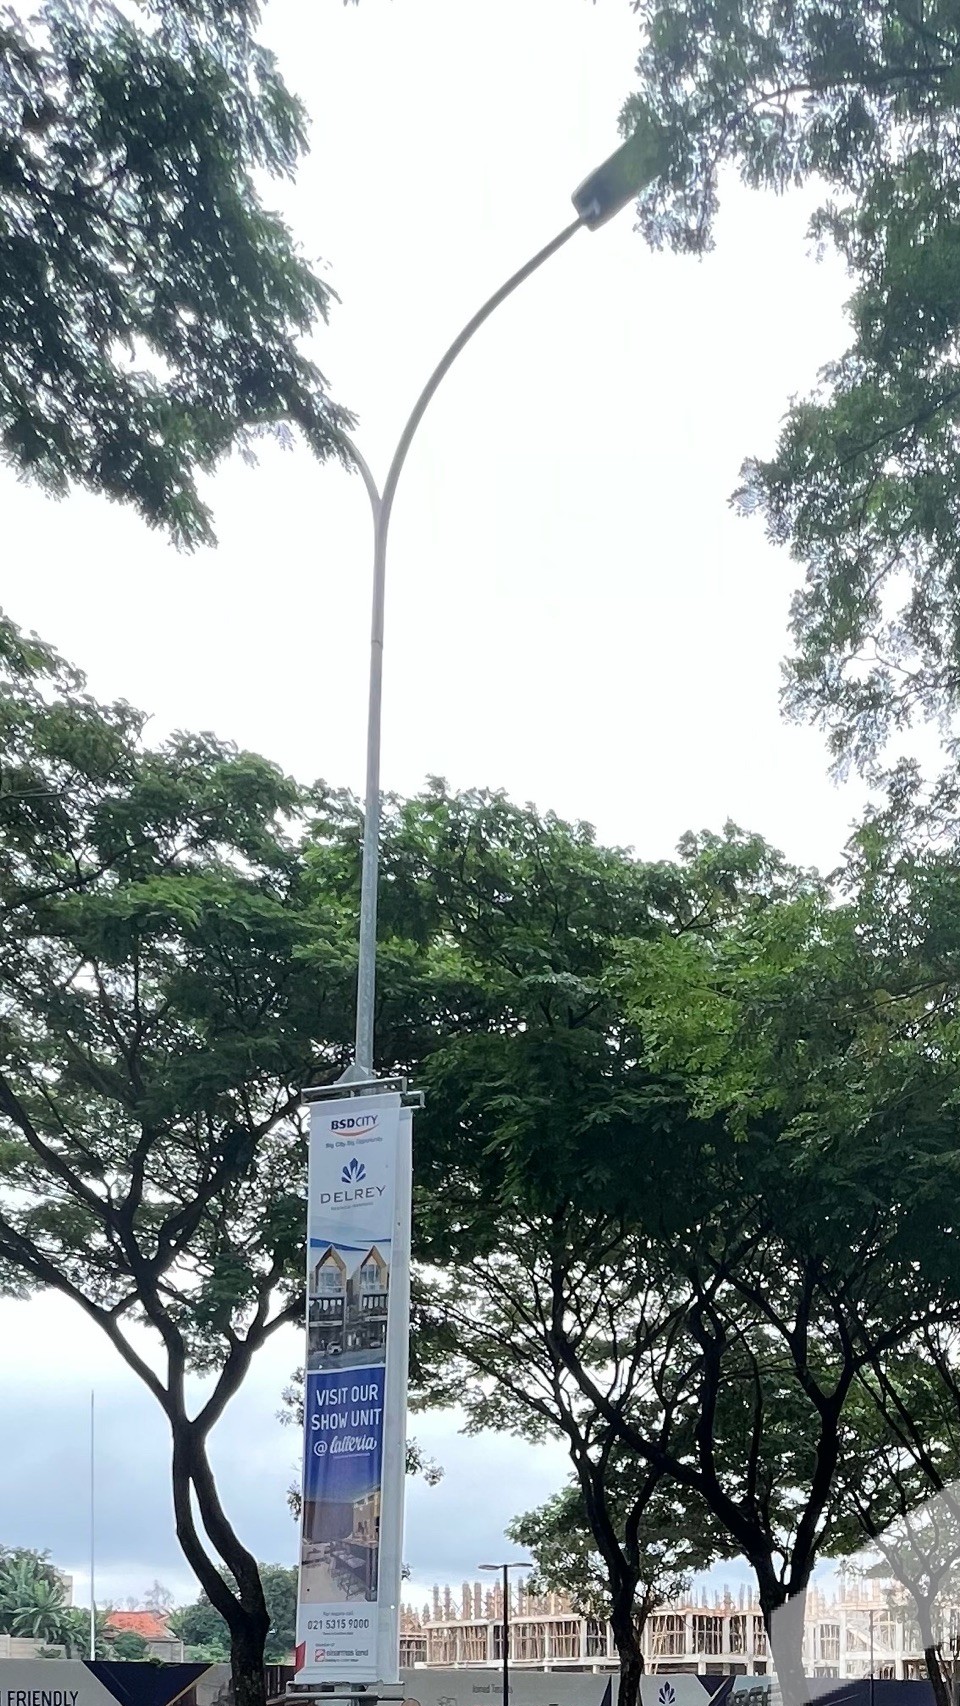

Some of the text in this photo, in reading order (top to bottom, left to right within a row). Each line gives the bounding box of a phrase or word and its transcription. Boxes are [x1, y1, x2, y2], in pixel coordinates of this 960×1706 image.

[320, 1185, 386, 1204] DELREY
[316, 1384, 378, 1406] VISIT OUR
[311, 1408, 382, 1430] SHOW UNIT
[307, 1618, 370, 1630] 021 5315 9000
[7, 1690, 79, 1706] FRIENDLY
